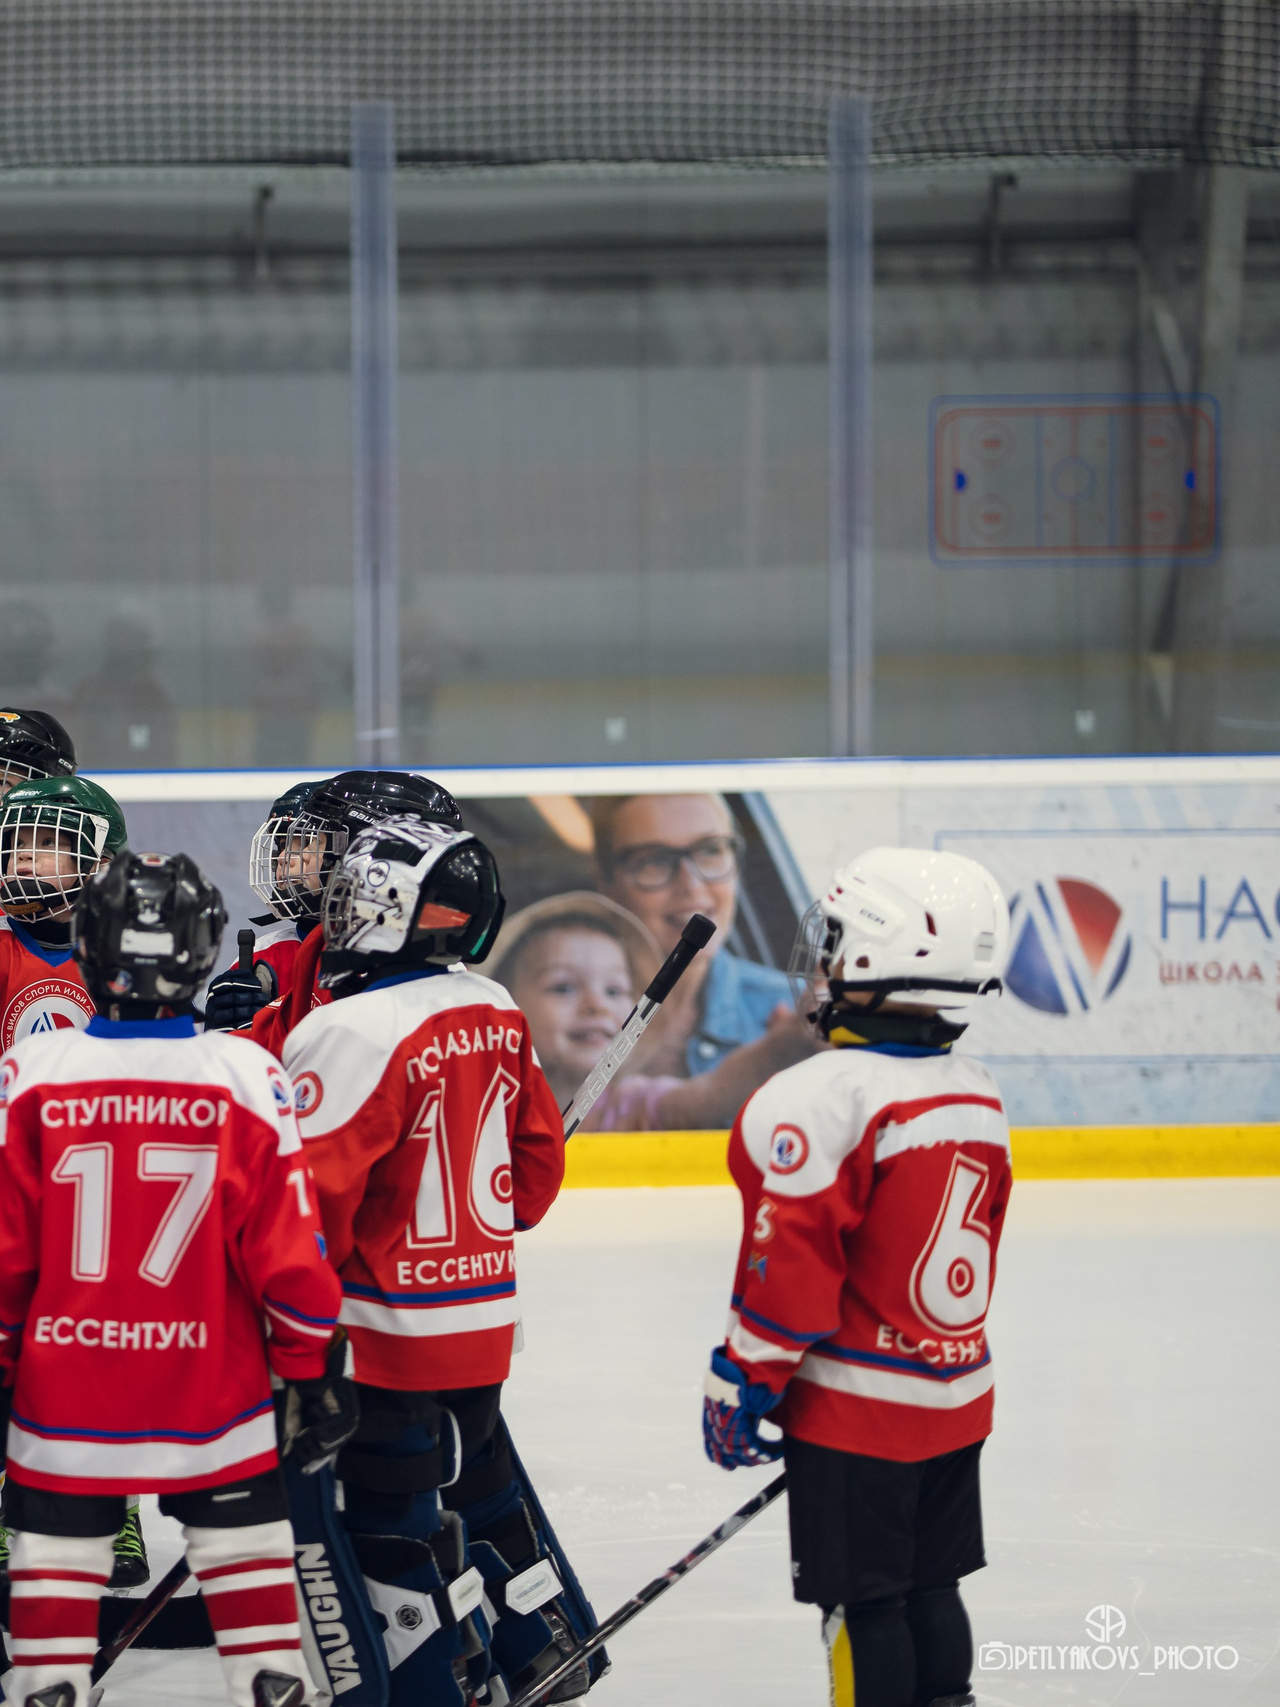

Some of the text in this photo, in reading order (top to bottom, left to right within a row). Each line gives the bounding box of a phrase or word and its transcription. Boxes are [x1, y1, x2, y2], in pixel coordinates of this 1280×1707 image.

[58, 757, 74, 770] CCM
[349, 810, 381, 825] BAUE
[859, 908, 885, 926] CCM
[1160, 876, 1280, 942] НА
[1159, 961, 1264, 985] ШКОЛА
[7, 985, 87, 1031] ВИДОВ СПОРТА ИЛЬИ
[407, 1062, 521, 1249] 16
[51, 1142, 219, 1288] 17
[909, 1151, 991, 1336] 6
[396, 1250, 516, 1285] ЕССЕНТУК
[876, 1324, 984, 1365] ЕССЕН
[294, 1542, 362, 1696] VAUGHN
